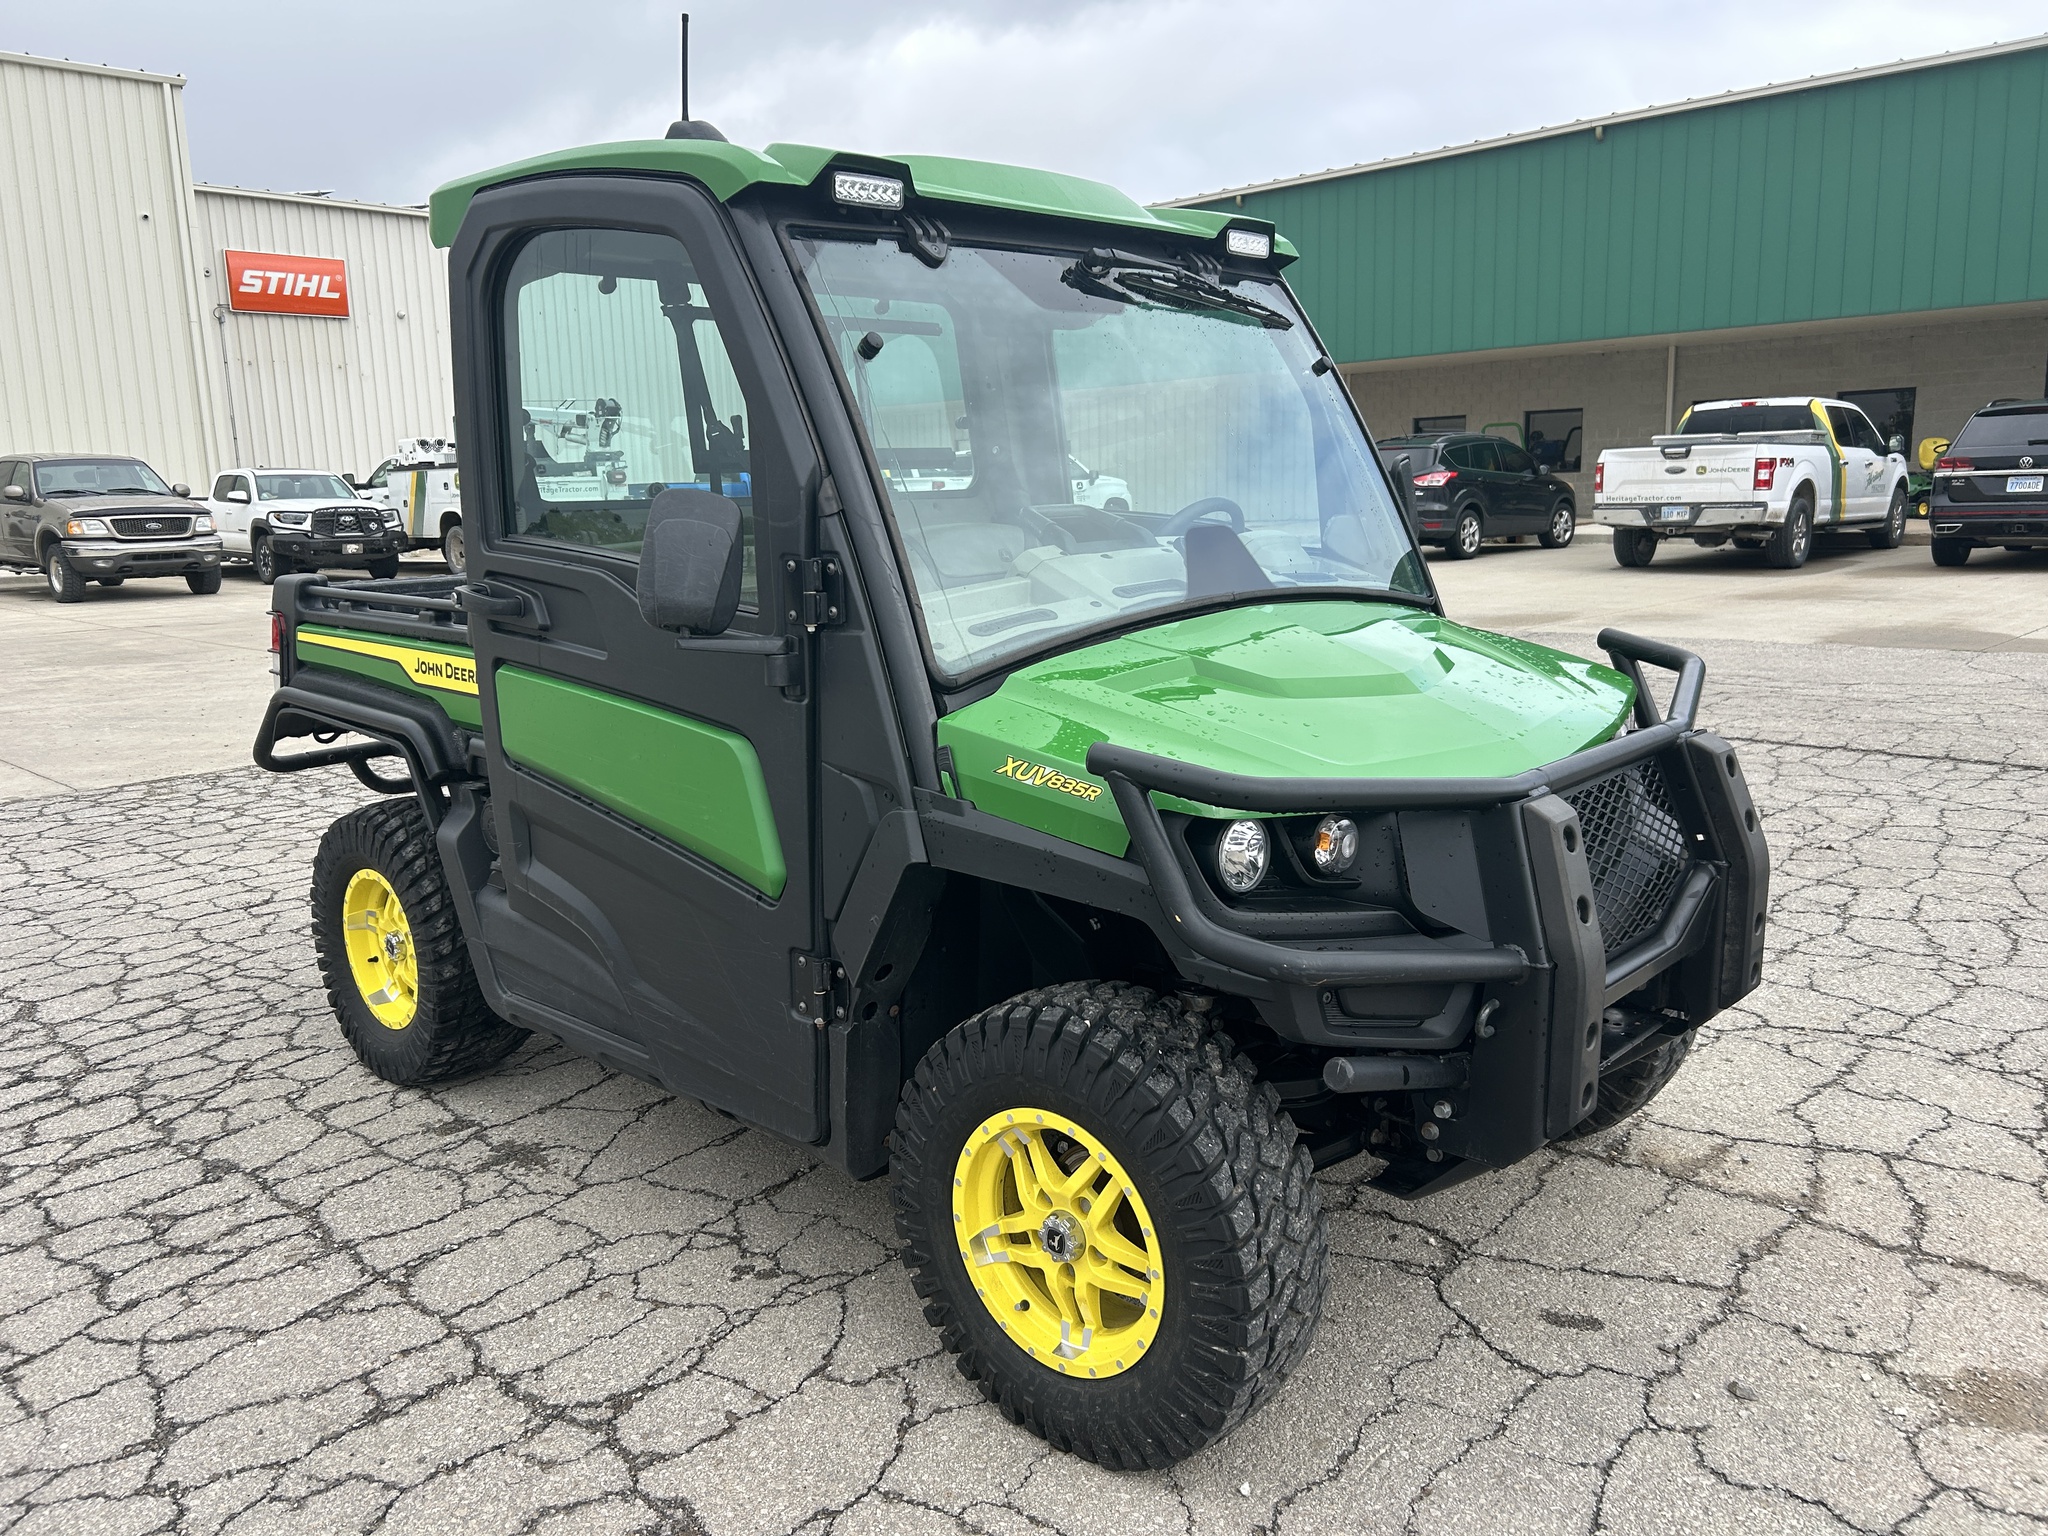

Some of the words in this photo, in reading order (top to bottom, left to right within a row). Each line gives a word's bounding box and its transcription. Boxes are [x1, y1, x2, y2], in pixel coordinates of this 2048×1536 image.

[238, 269, 341, 299] STIHL
[1779, 457, 1795, 468] FX4
[540, 486, 599, 496] itageTractor.com
[1606, 495, 1682, 503] HeritageTractor.com
[414, 657, 443, 678] JOHN
[445, 662, 478, 684] DEER
[993, 755, 1104, 802] XUV835R
